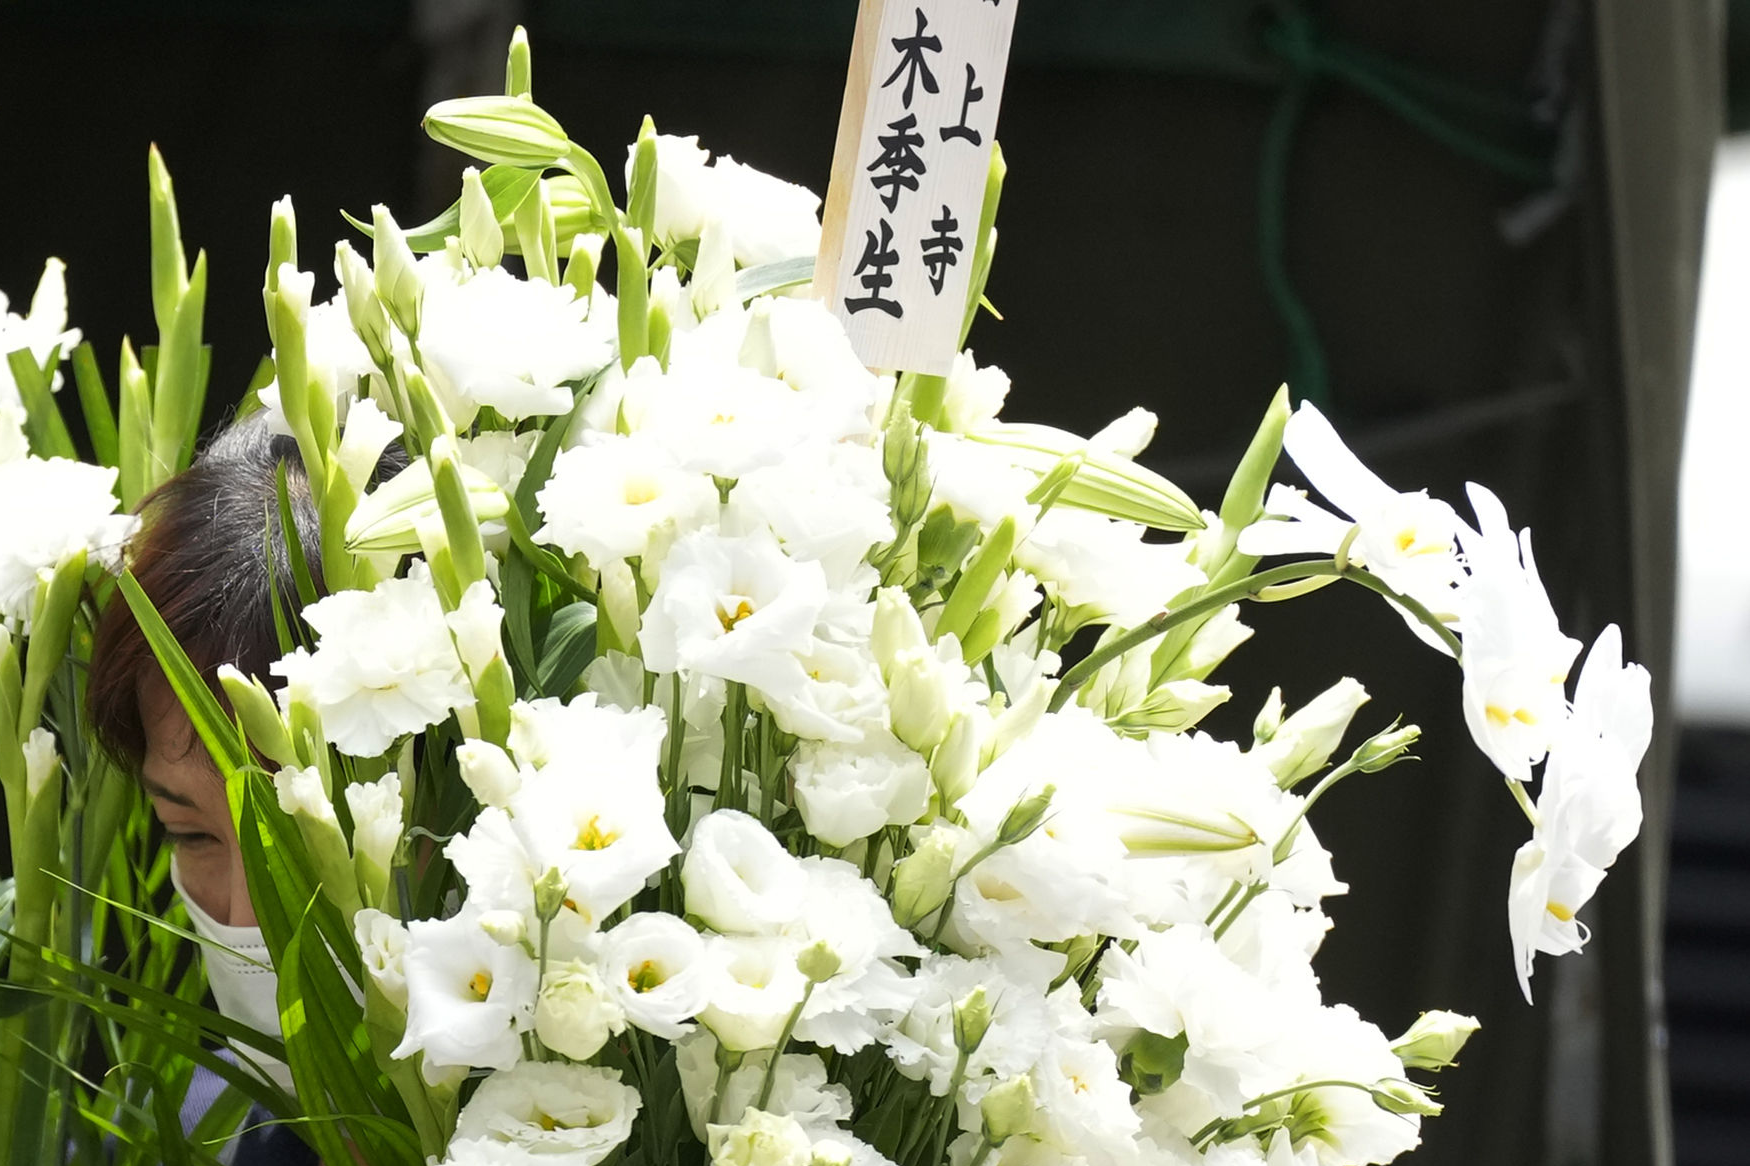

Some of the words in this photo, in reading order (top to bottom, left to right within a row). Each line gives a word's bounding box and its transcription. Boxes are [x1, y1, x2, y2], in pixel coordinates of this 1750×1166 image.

[844, 7, 943, 319] 木季生
[919, 0, 1000, 297] 上寺
